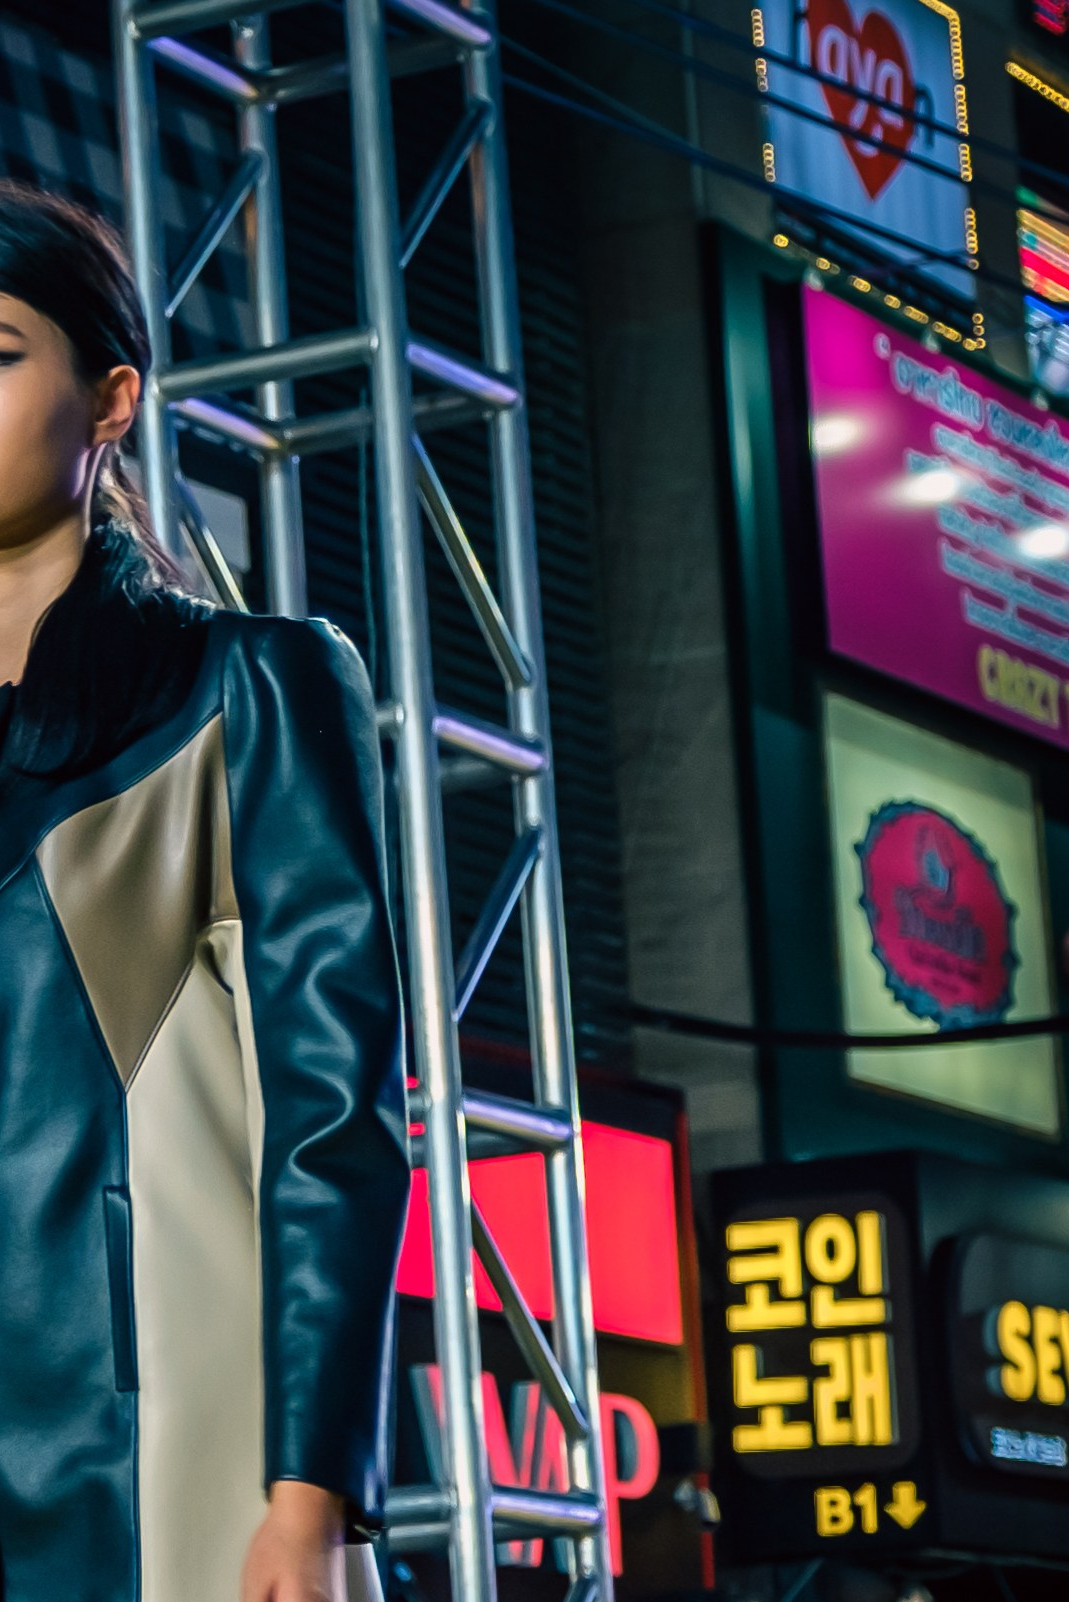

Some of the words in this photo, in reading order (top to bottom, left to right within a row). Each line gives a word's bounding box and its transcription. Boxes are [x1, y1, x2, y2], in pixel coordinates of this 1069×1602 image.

[726, 1210, 888, 1333] 코인
[732, 1331, 894, 1453] 노래
[995, 1299, 1069, 1406] SE
[814, 1481, 880, 1537] B1
